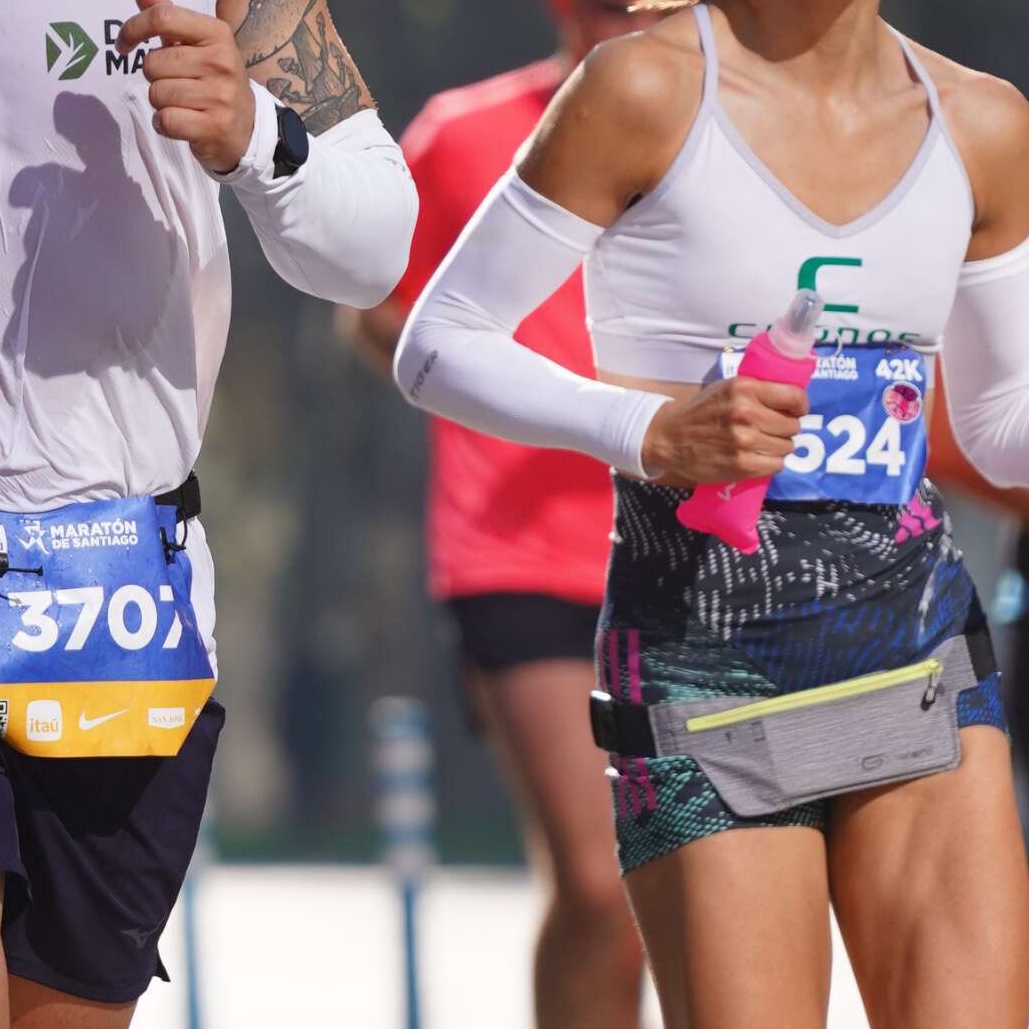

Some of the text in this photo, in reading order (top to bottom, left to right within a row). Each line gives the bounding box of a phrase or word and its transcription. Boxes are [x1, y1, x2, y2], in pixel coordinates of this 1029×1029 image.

[105, 48, 155, 76] MA
[875, 358, 923, 381] 42K
[50, 517, 138, 539] MARATÓN
[51, 534, 139, 549] DE SANTIAGO
